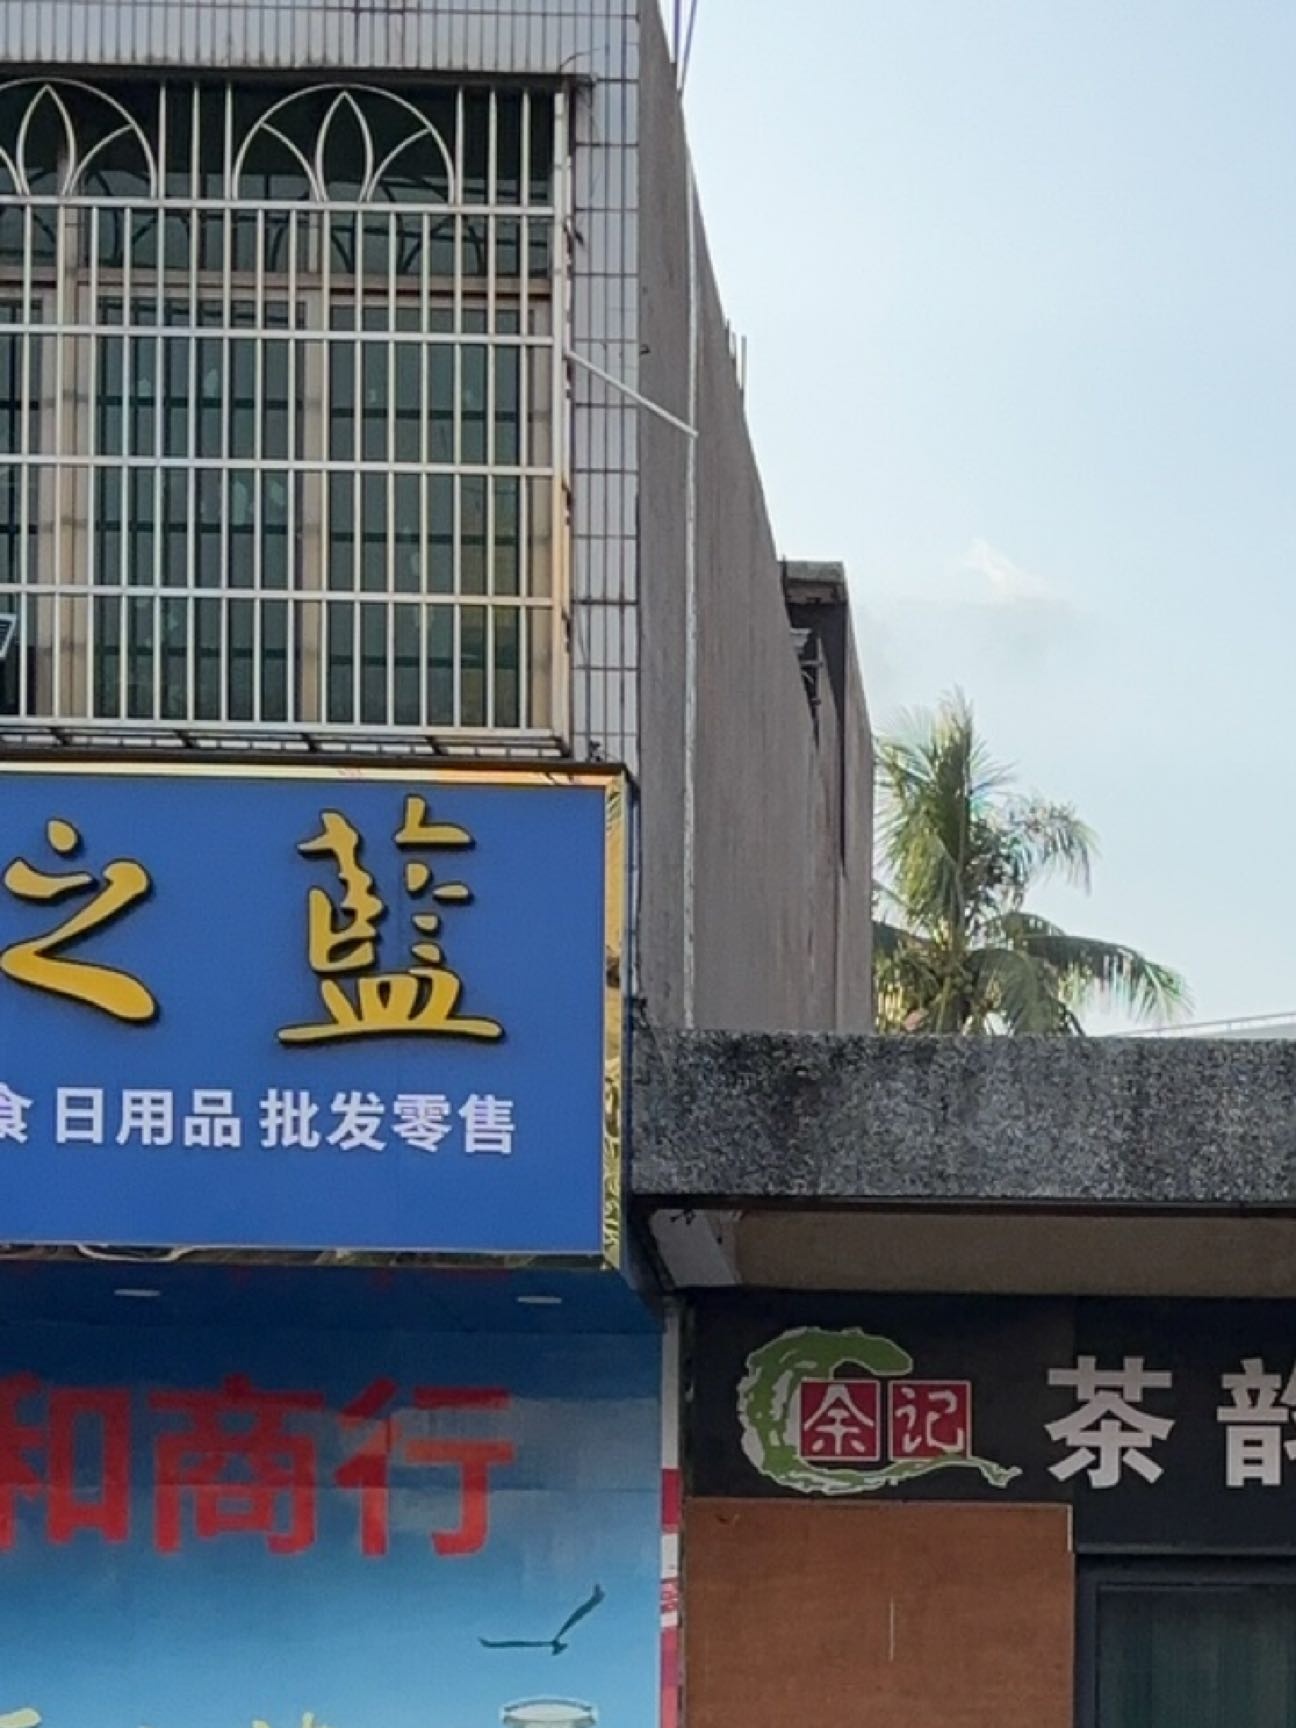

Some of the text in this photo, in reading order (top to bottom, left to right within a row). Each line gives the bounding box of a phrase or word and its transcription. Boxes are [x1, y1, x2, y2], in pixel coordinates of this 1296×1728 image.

[56, 1087, 242, 1148] 日用品
[259, 1088, 516, 1155] 批发零售
